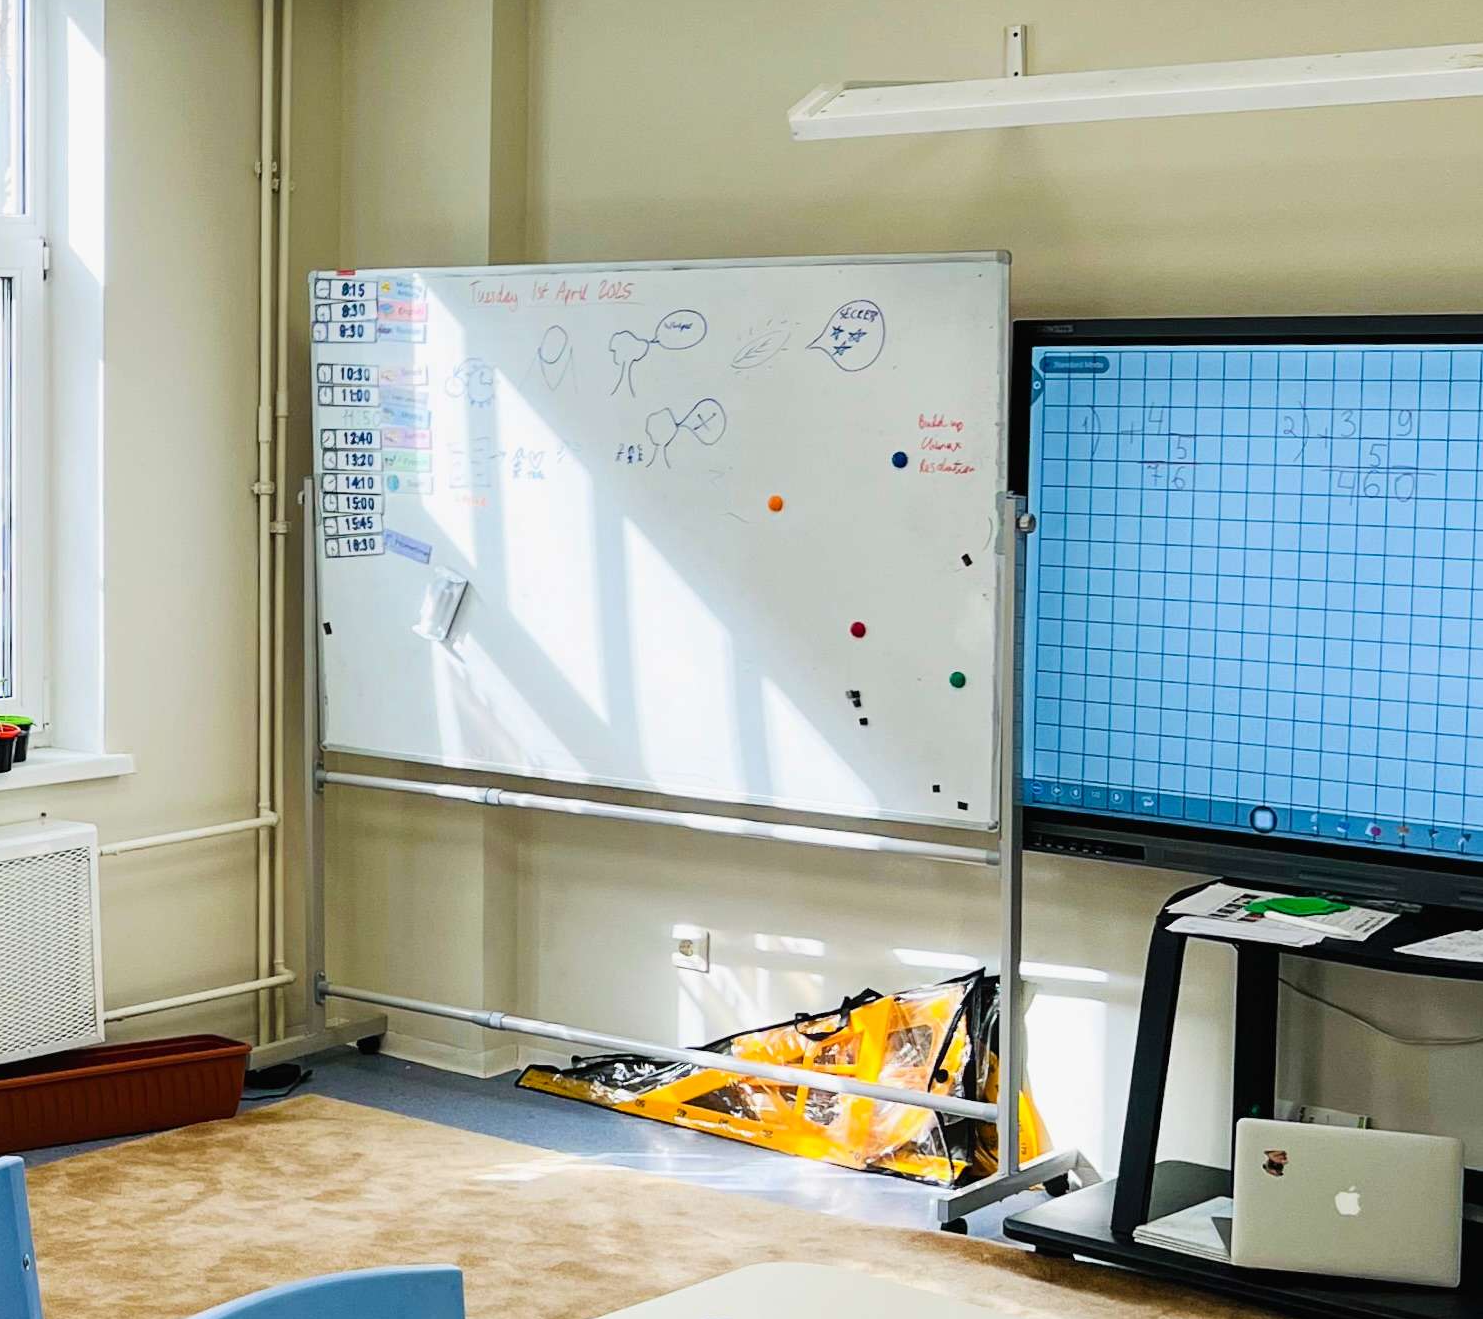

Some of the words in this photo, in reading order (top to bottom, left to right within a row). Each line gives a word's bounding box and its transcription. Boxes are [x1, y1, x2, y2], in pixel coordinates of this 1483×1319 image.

[342, 282, 365, 298] 8:15
[469, 280, 518, 312] Tuesday
[532, 281, 549, 300] 1st
[556, 281, 589, 306] April
[598, 279, 635, 301] 2025
[342, 303, 365, 318] 8:30
[340, 367, 371, 381] 10:30
[342, 388, 371, 403] 11:00
[343, 431, 373, 446] 12:40
[345, 453, 374, 467] 13:20
[345, 475, 374, 490] 14:10
[346, 496, 375, 511] 15:00
[346, 516, 374, 531] 15:45
